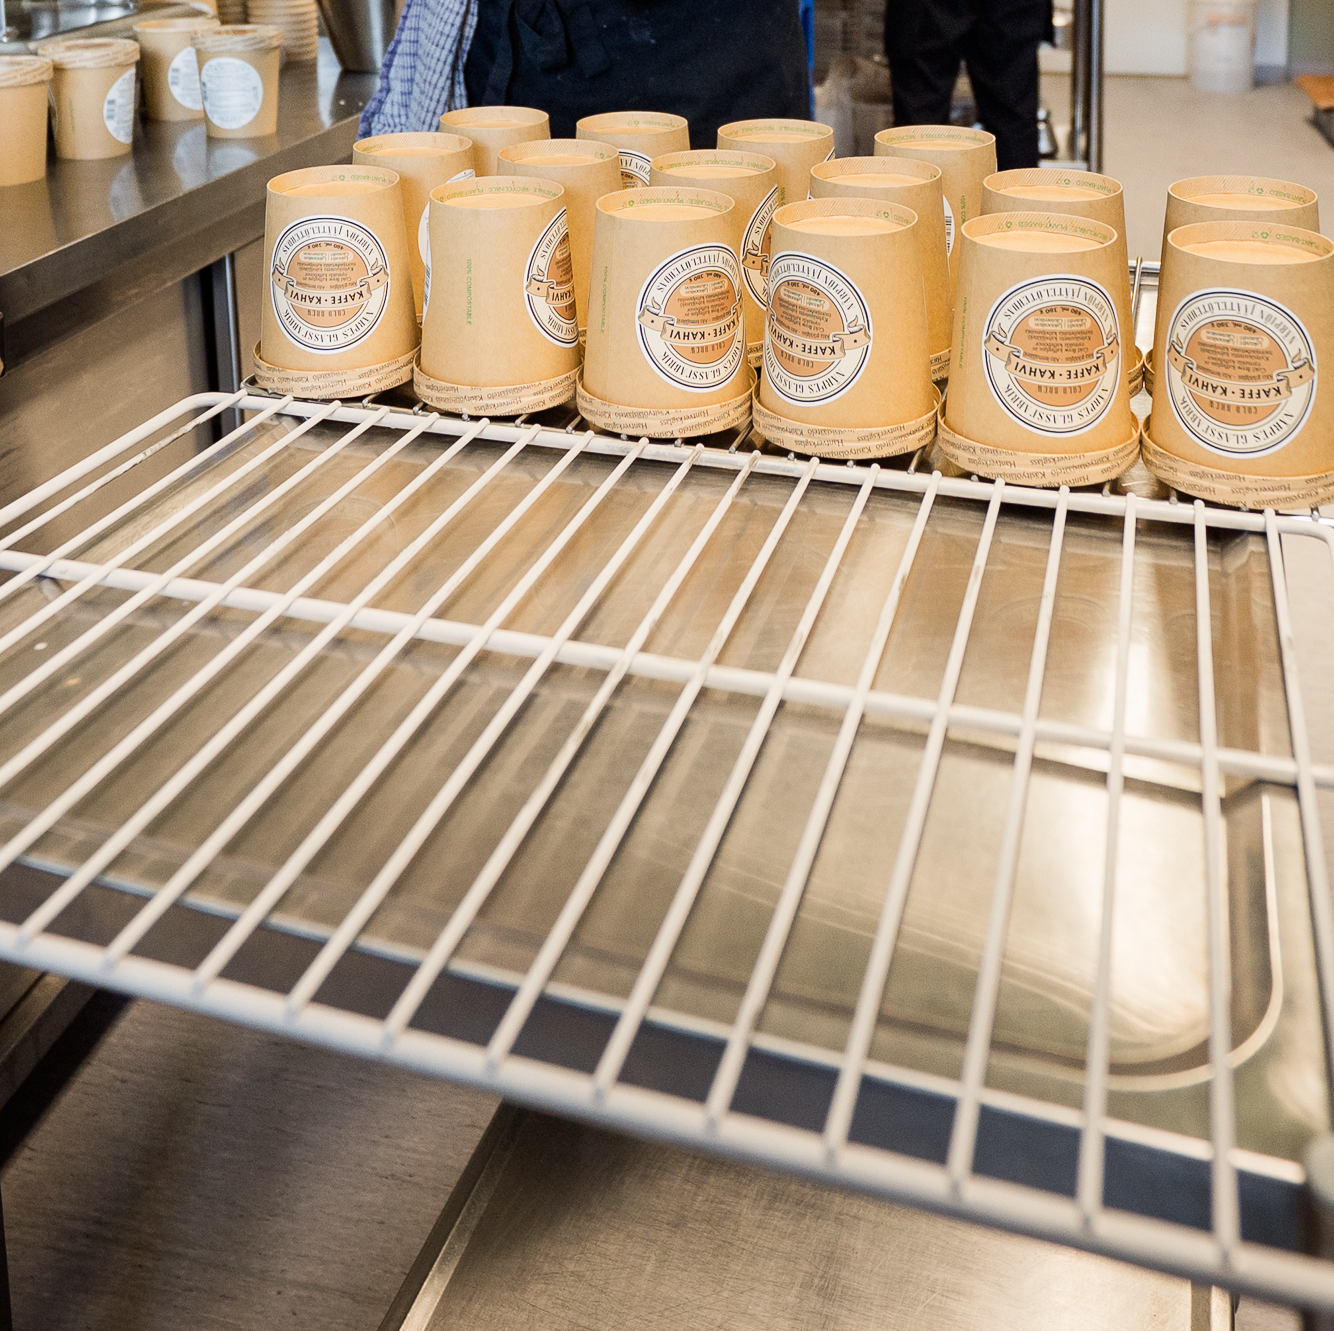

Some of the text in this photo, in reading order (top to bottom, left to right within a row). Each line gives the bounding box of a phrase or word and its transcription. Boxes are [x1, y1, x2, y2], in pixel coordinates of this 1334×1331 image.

[290, 290, 364, 305] KAFFE KAHVI
[669, 319, 736, 340] KAFFE KAHVI
[770, 323, 835, 356] KAFFE KAHVI
[1014, 362, 1100, 380] KAFFE KAHVI
[1188, 374, 1282, 399] KAFFE KAHVI
